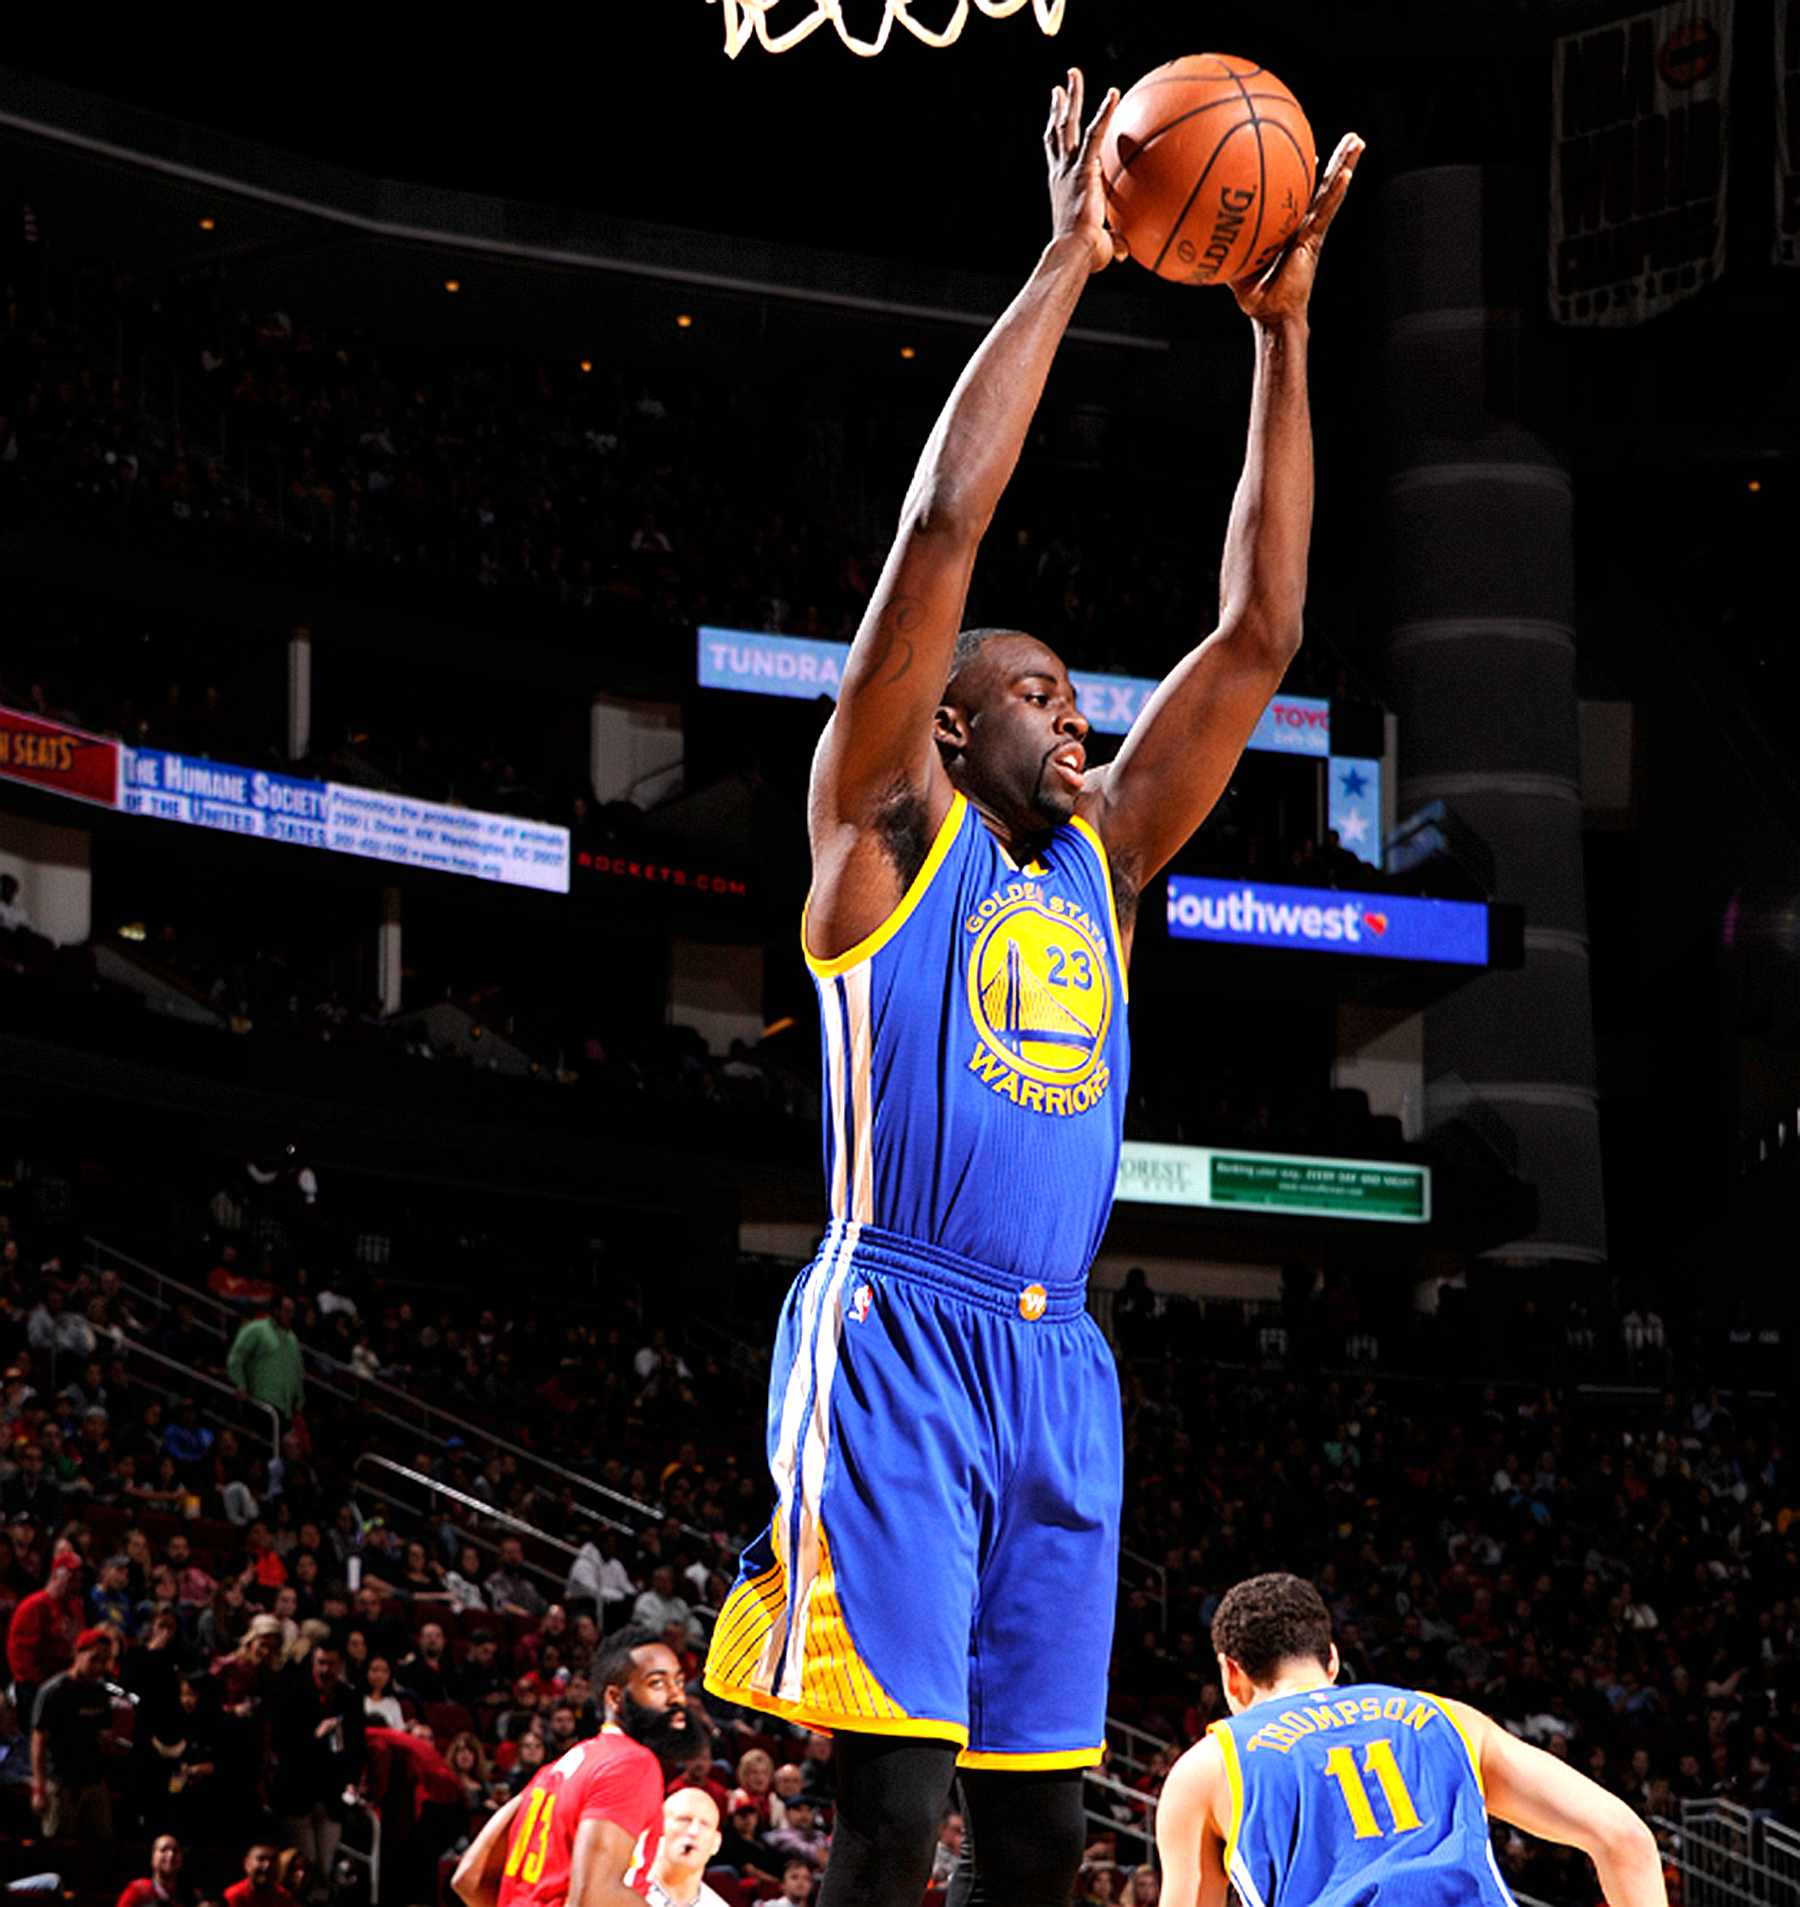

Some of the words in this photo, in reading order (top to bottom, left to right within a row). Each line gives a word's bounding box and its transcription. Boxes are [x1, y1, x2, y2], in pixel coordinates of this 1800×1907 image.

[709, 642, 840, 685] TUNDRA
[14, 733, 78, 770] SEATS
[164, 753, 247, 804] HUMANE
[251, 772, 327, 819] SOCIETY
[150, 796, 178, 816] THE
[187, 797, 256, 833] UNITED
[263, 813, 327, 848] STATES
[577, 851, 747, 896] ROCKETS.COM
[1046, 945, 1093, 991] 23
[967, 1042, 1110, 1116] WARRIORS
[1246, 1697, 1439, 1753] THOMPSON
[1324, 1738, 1424, 1840] 11
[505, 1787, 556, 1884] 13
